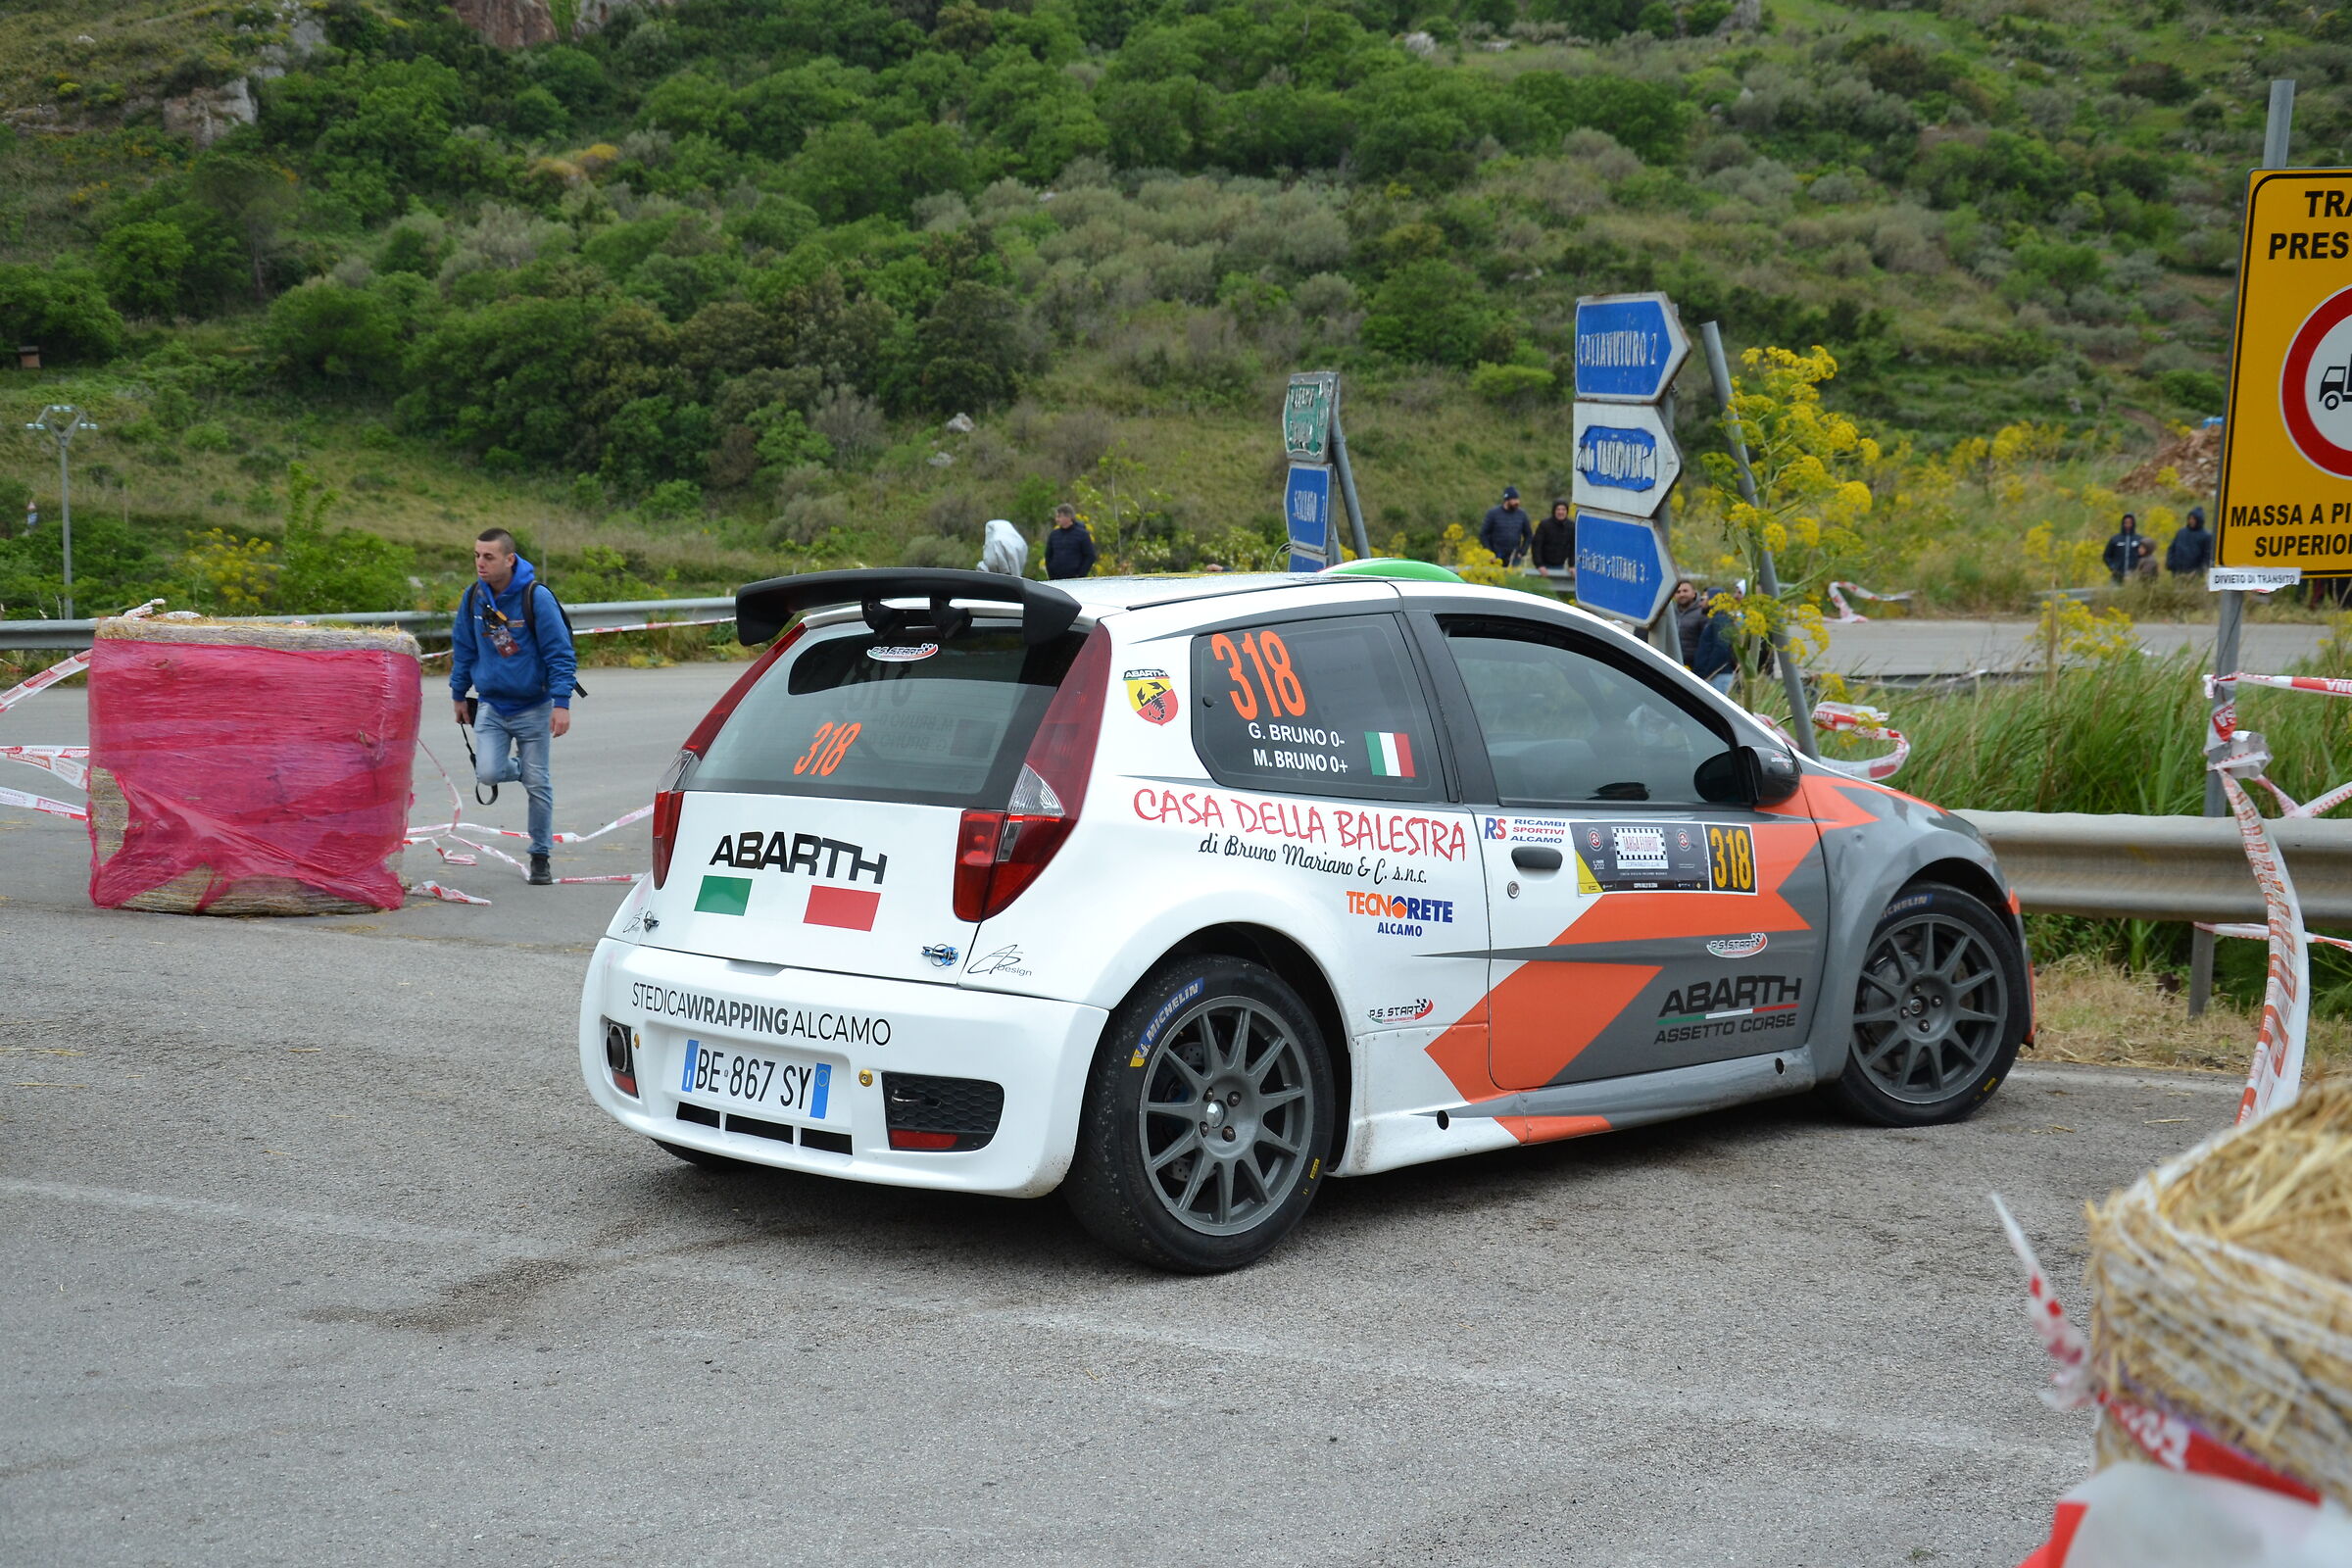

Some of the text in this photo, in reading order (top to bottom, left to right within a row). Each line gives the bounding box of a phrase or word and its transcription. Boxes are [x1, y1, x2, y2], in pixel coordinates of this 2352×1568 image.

[2230, 504, 2303, 527] MASSA
[2310, 503, 2324, 524] A
[2255, 533, 2352, 558] SUPERIO
[2215, 574, 2295, 585] DIVIETO DI TRANSITO
[1211, 630, 1306, 720] 318
[1248, 722, 1266, 739] G.
[1268, 724, 1327, 746] BRUNO
[793, 721, 861, 776] 318
[1252, 749, 1273, 767] M.
[1274, 750, 1327, 771] BRUNO
[1133, 788, 1466, 861] CASA DELLA BALESTRA
[1485, 817, 1506, 840] RS
[1512, 826, 1565, 835] SPORTIVI
[1514, 818, 1566, 827] RICAMBI
[1510, 835, 1562, 844] ALCAMO
[710, 831, 887, 884] ABARTH
[1198, 833, 1218, 854] di
[1224, 836, 1277, 862] Bruno
[1282, 845, 1353, 877] Mariano
[1357, 857, 1371, 877] &
[1710, 827, 1752, 890] 318
[1347, 891, 1453, 923] TECNORETE
[1882, 896, 1928, 918] ICHELIN
[1377, 922, 1423, 937] ALCAMO
[1658, 975, 1802, 1017] ABARTH
[1146, 983, 1199, 1042] MICHELIN
[1388, 1004, 1421, 1017] START
[1653, 1012, 1796, 1045] ASSETTO CORSE
[695, 1049, 812, 1109] BE 867 SY
